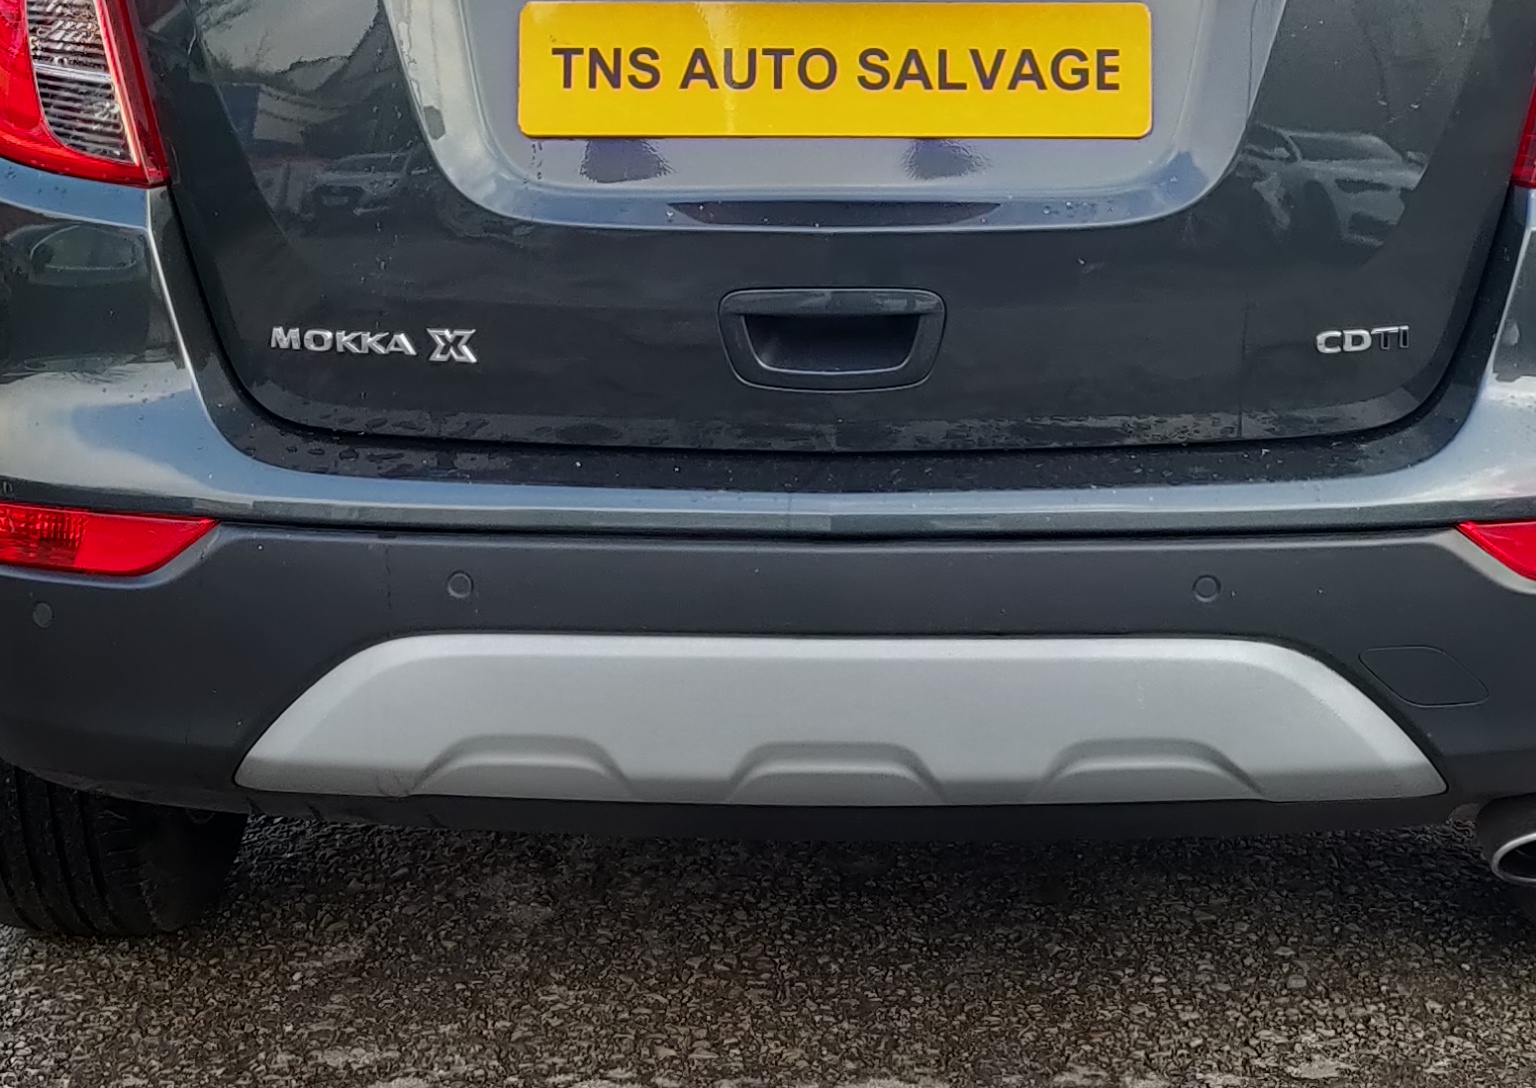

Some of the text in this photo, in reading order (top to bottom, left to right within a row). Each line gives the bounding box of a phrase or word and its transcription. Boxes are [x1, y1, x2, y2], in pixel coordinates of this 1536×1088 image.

[551, 46, 1121, 92] TNS AUTO SALVAGE
[270, 325, 478, 364] MOKKA X
